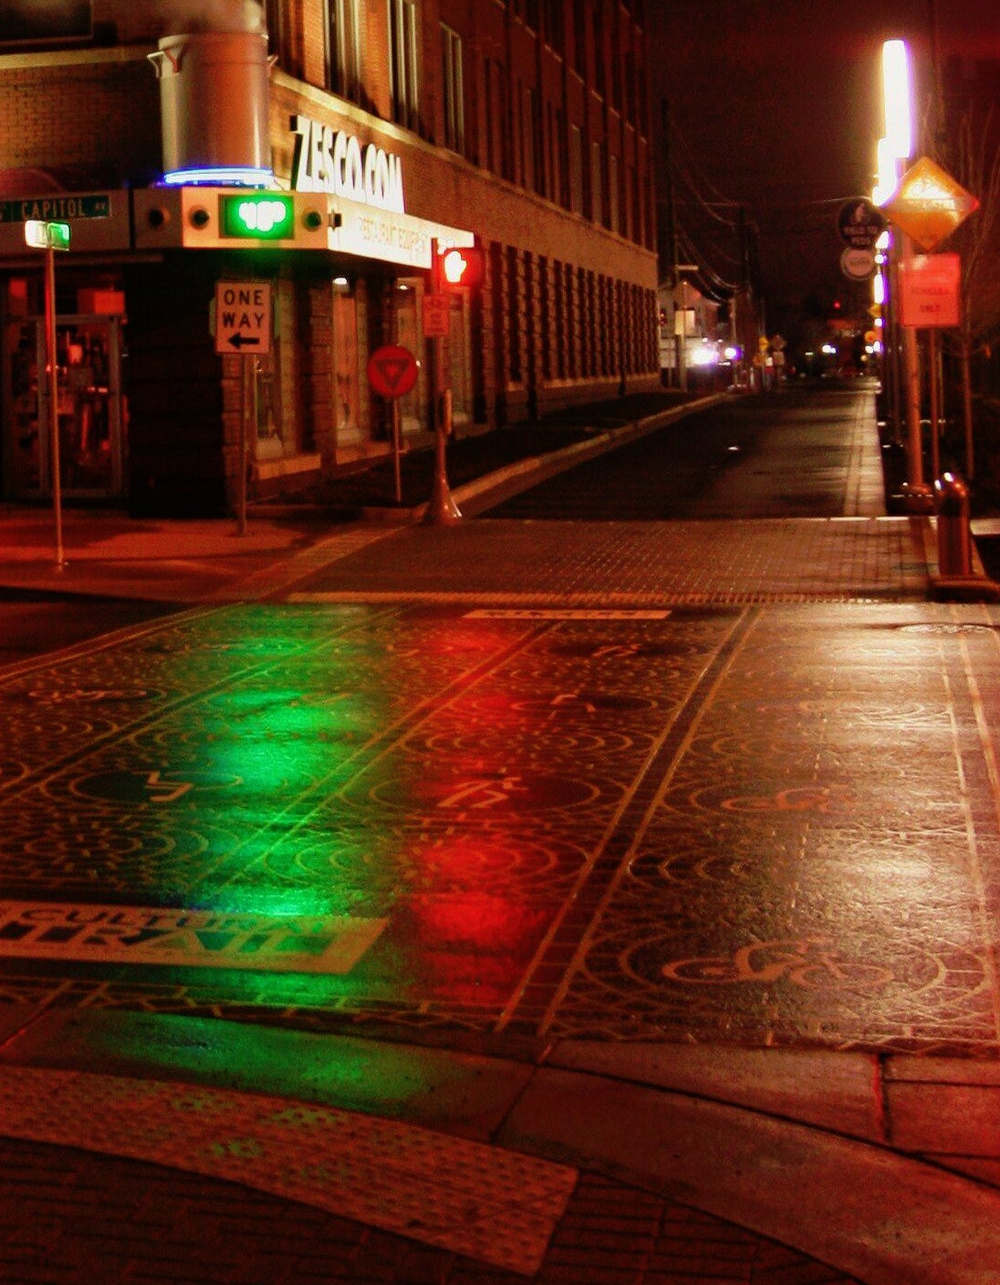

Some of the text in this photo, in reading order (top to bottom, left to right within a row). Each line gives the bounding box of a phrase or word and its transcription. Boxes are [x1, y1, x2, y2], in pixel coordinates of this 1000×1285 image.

[21, 198, 85, 219] CAPITOL
[224, 289, 264, 306] ONE
[222, 312, 265, 329] WAY
[19, 906, 328, 934] CULTURAL
